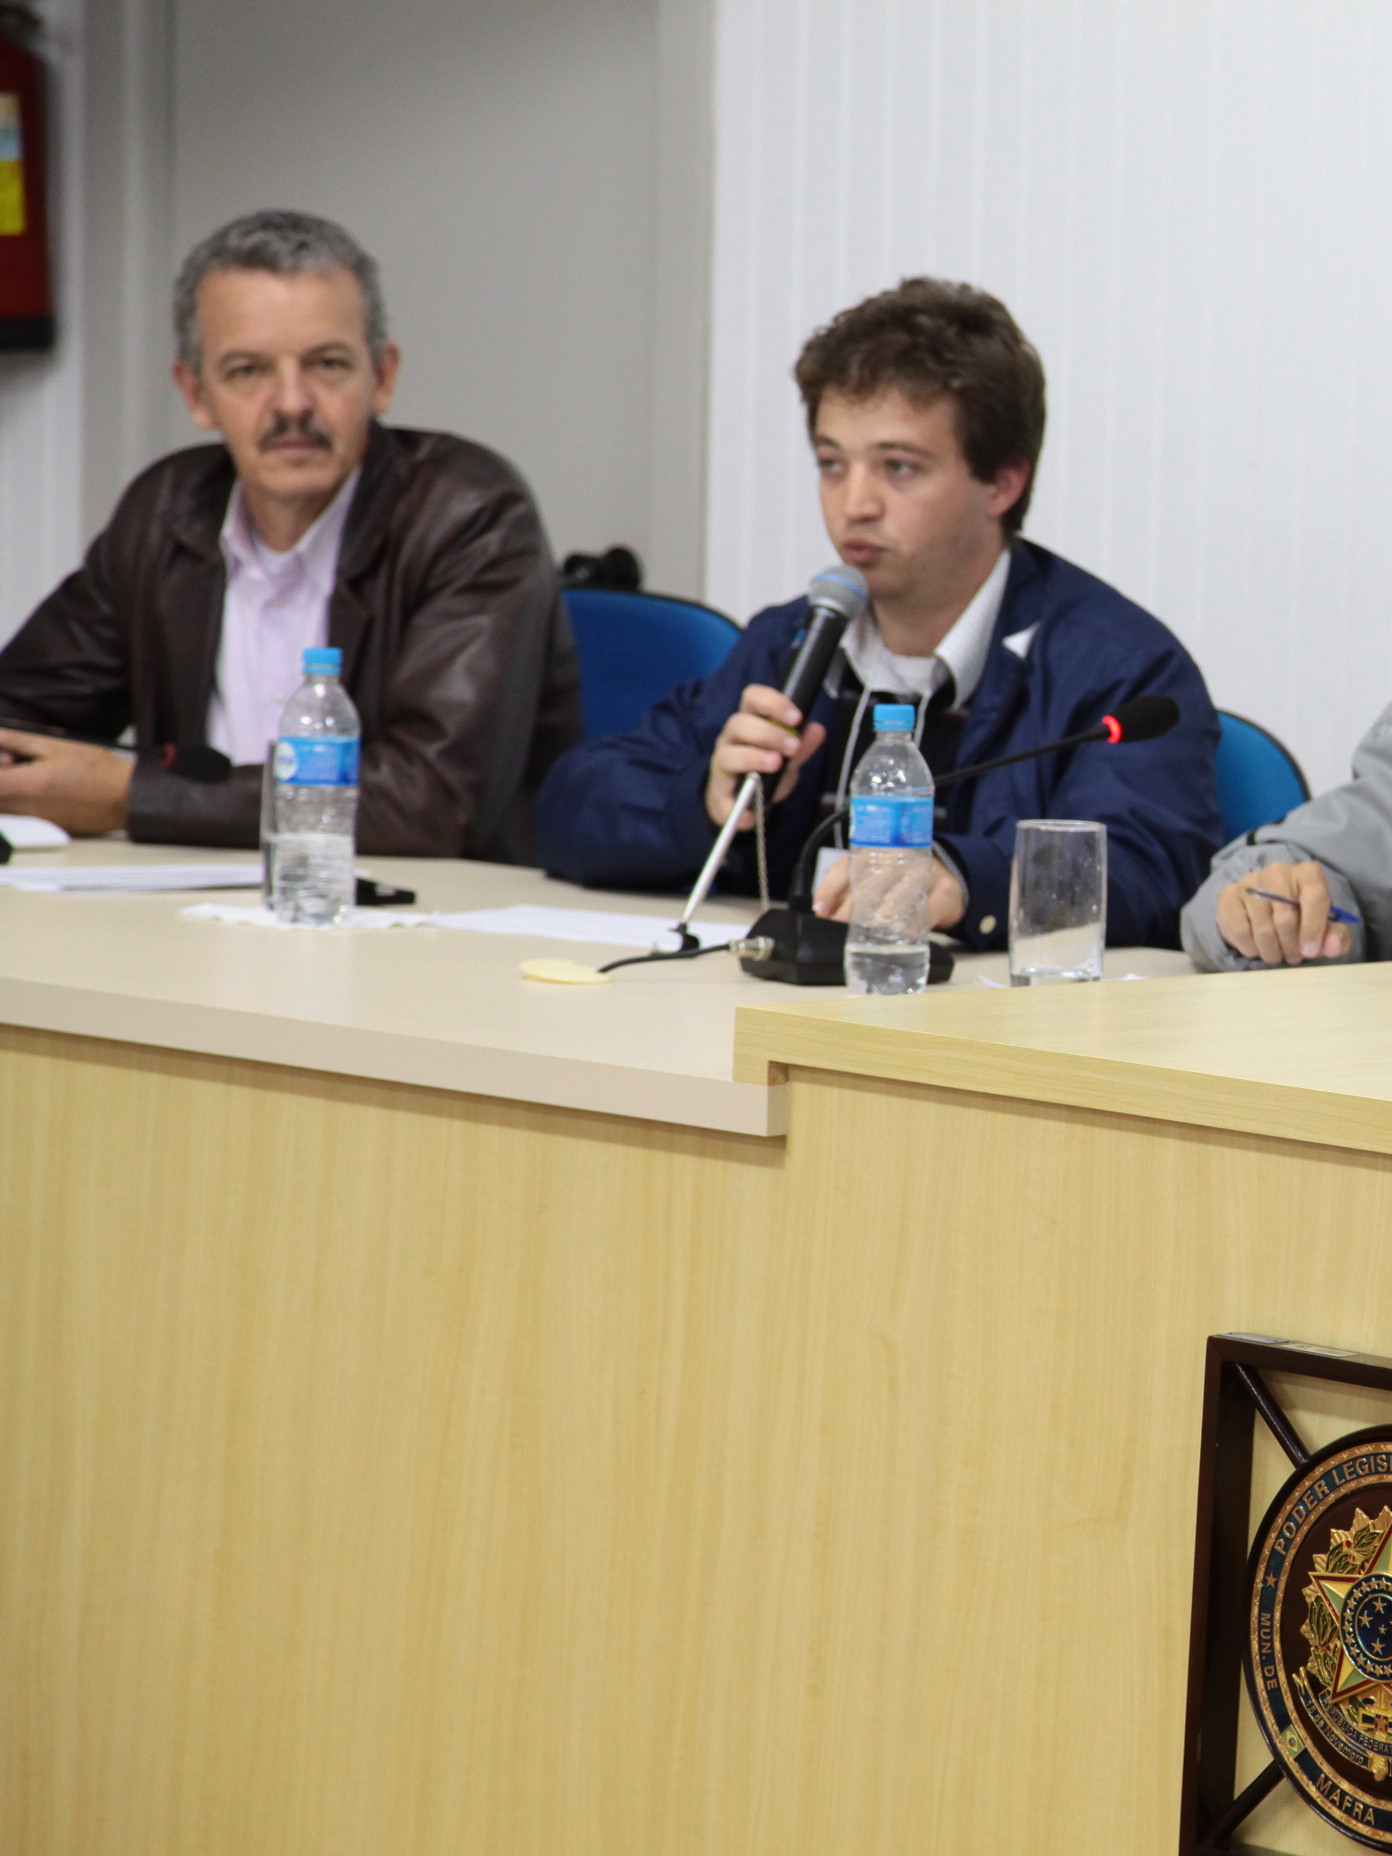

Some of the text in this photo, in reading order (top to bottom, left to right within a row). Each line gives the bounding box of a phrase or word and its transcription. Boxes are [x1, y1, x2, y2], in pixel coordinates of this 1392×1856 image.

[1274, 1480, 1330, 1556] PODER
[1260, 1612, 1278, 1691] MUN. DE
[1325, 1726, 1364, 1765] Novembro
[1315, 1773, 1375, 1826] MAFRA
